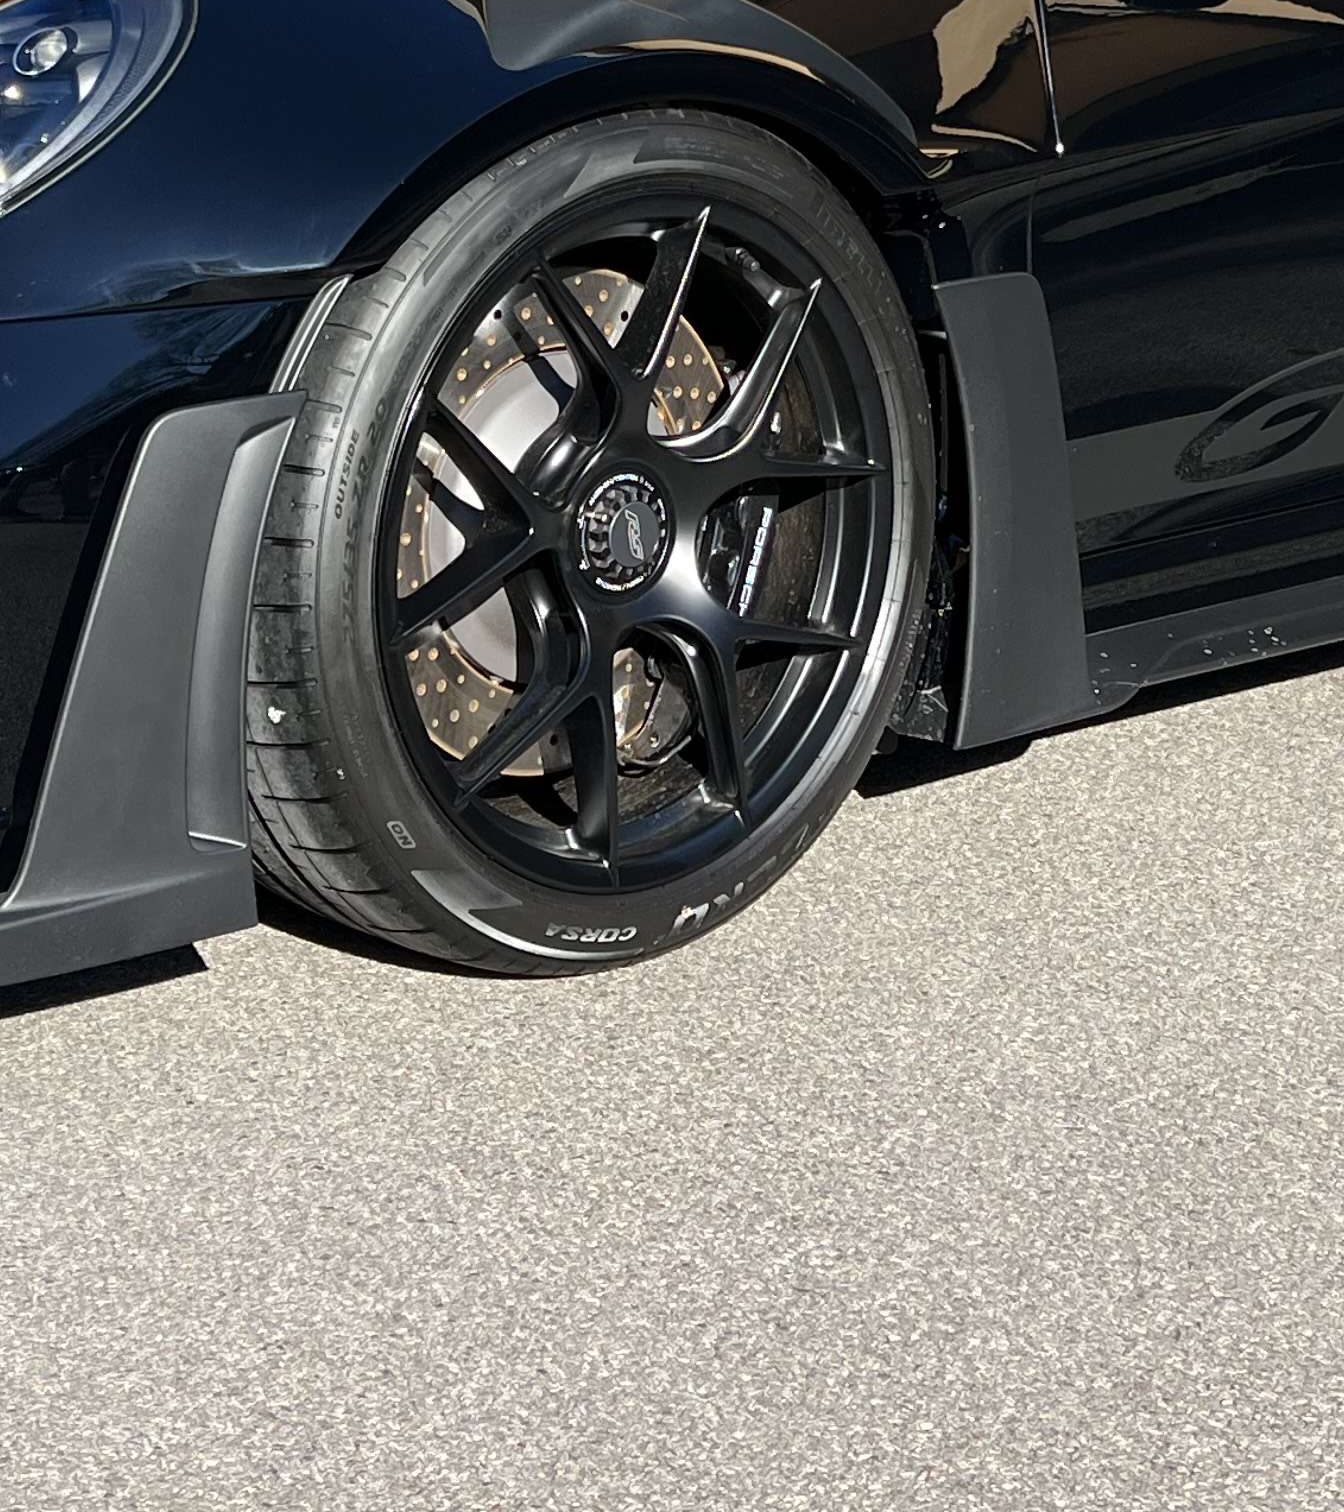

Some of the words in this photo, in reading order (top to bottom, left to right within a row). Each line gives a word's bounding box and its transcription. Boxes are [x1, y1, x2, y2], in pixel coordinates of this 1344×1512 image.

[334, 428, 360, 520] OUTSIDE
[738, 507, 773, 617] PORSCH
[545, 922, 638, 943] CORSA
